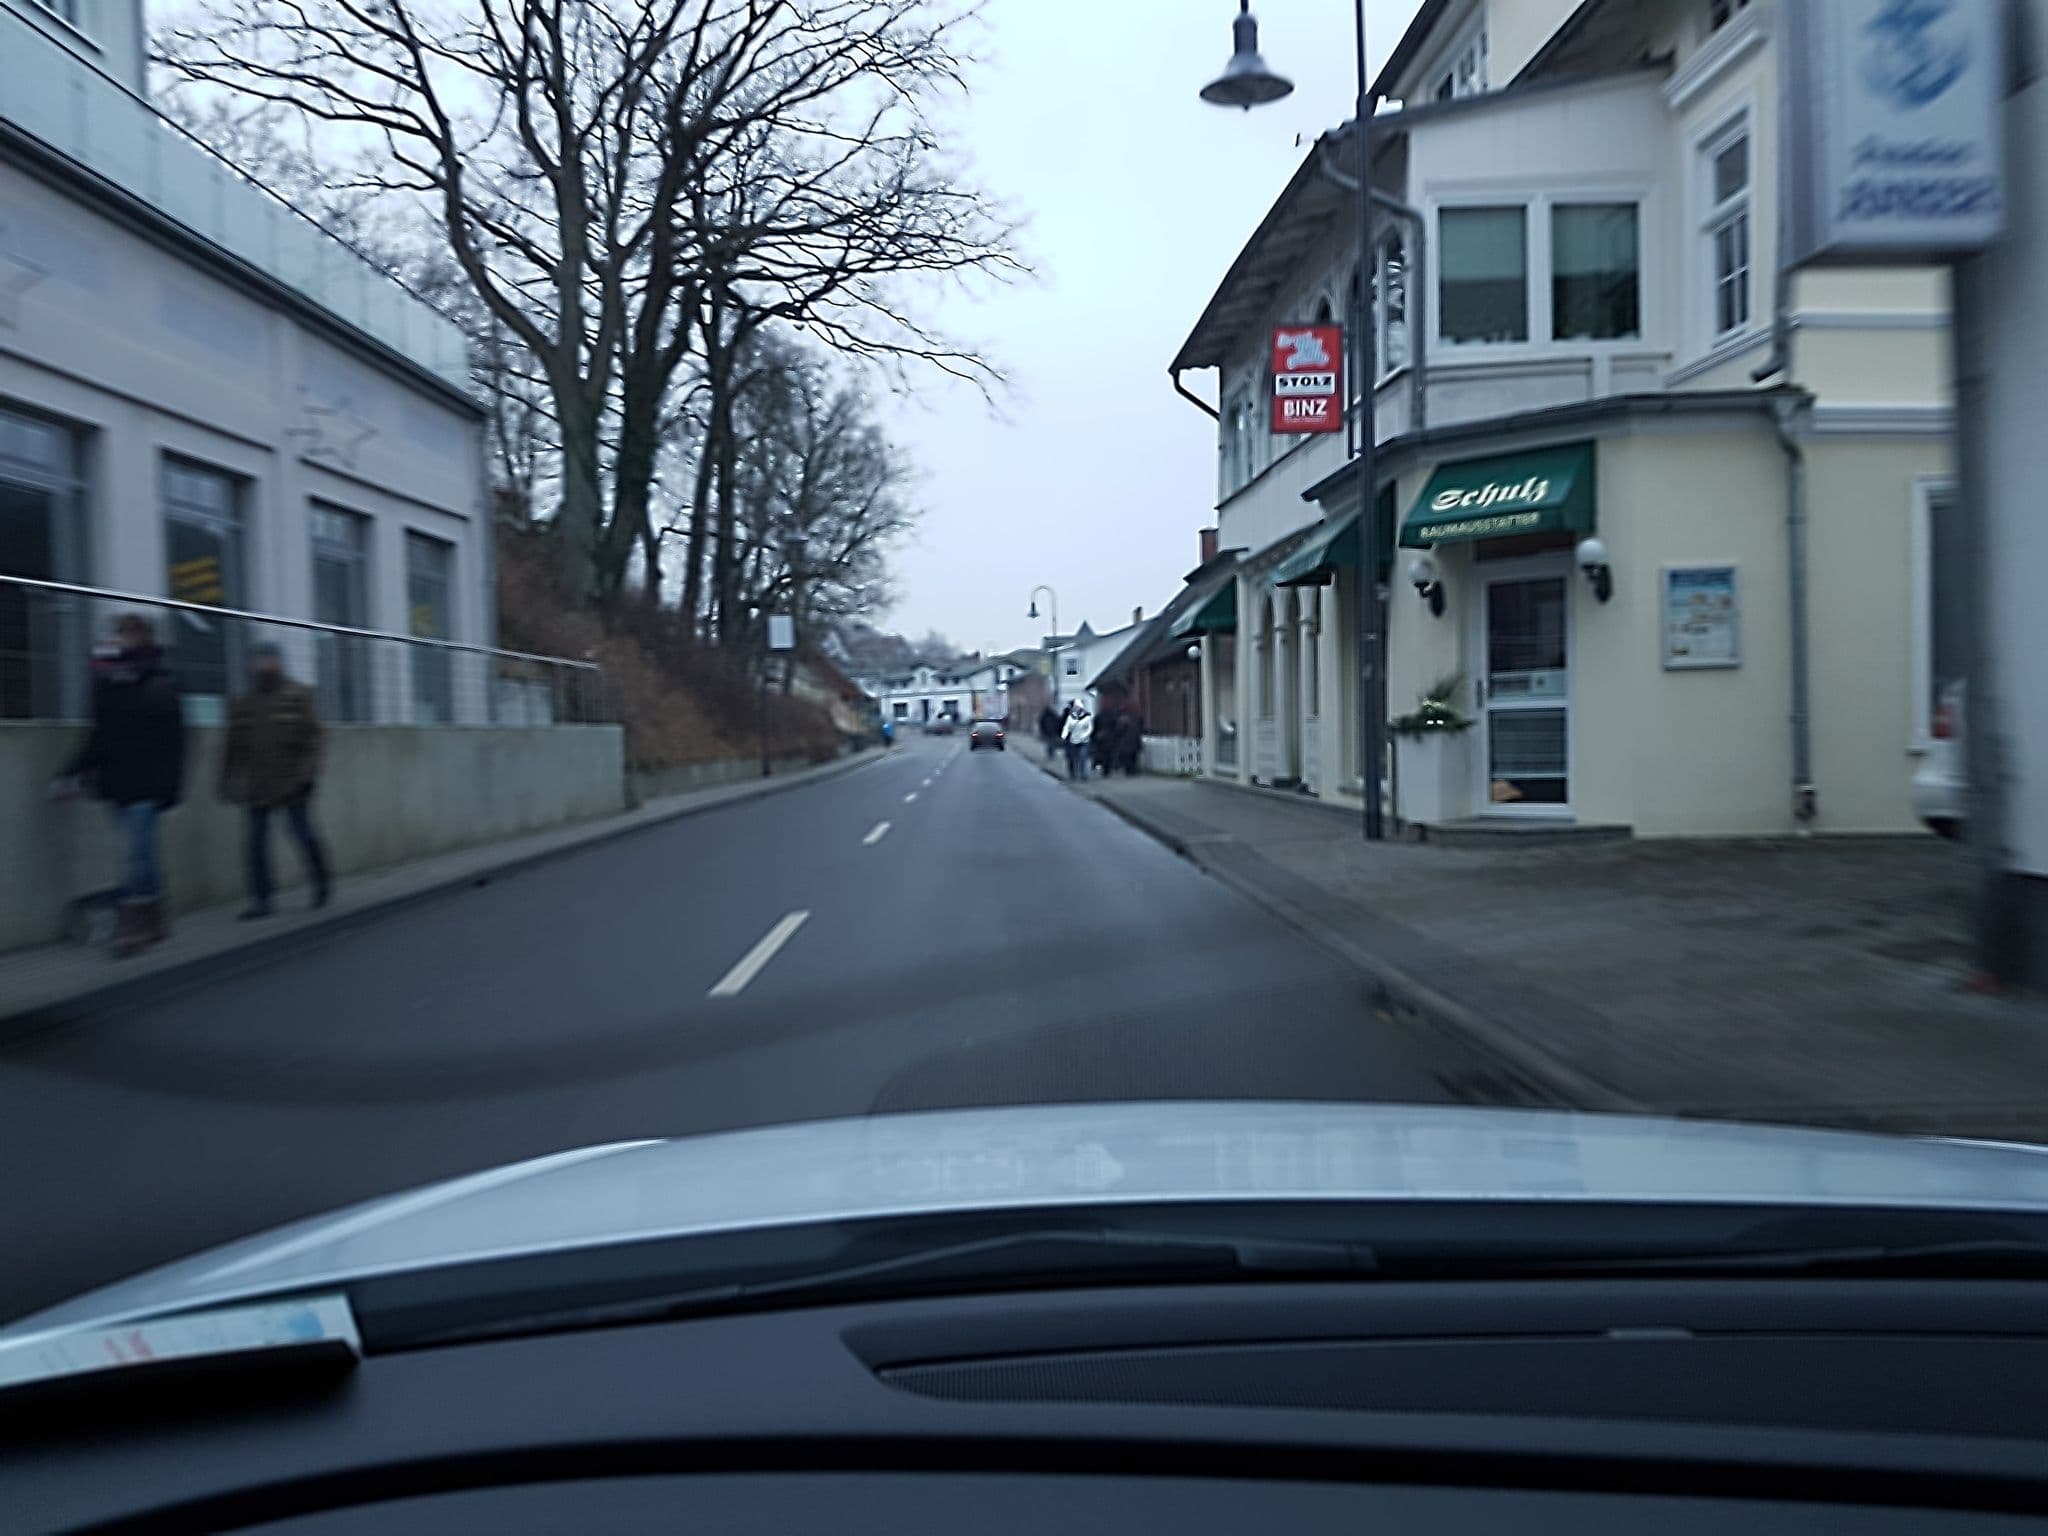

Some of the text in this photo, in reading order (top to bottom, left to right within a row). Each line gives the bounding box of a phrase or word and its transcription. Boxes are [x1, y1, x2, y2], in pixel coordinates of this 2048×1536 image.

[1279, 376, 1332, 387] STOLZ
[1283, 399, 1328, 416] BINZ
[1431, 476, 1549, 511] Schulz
